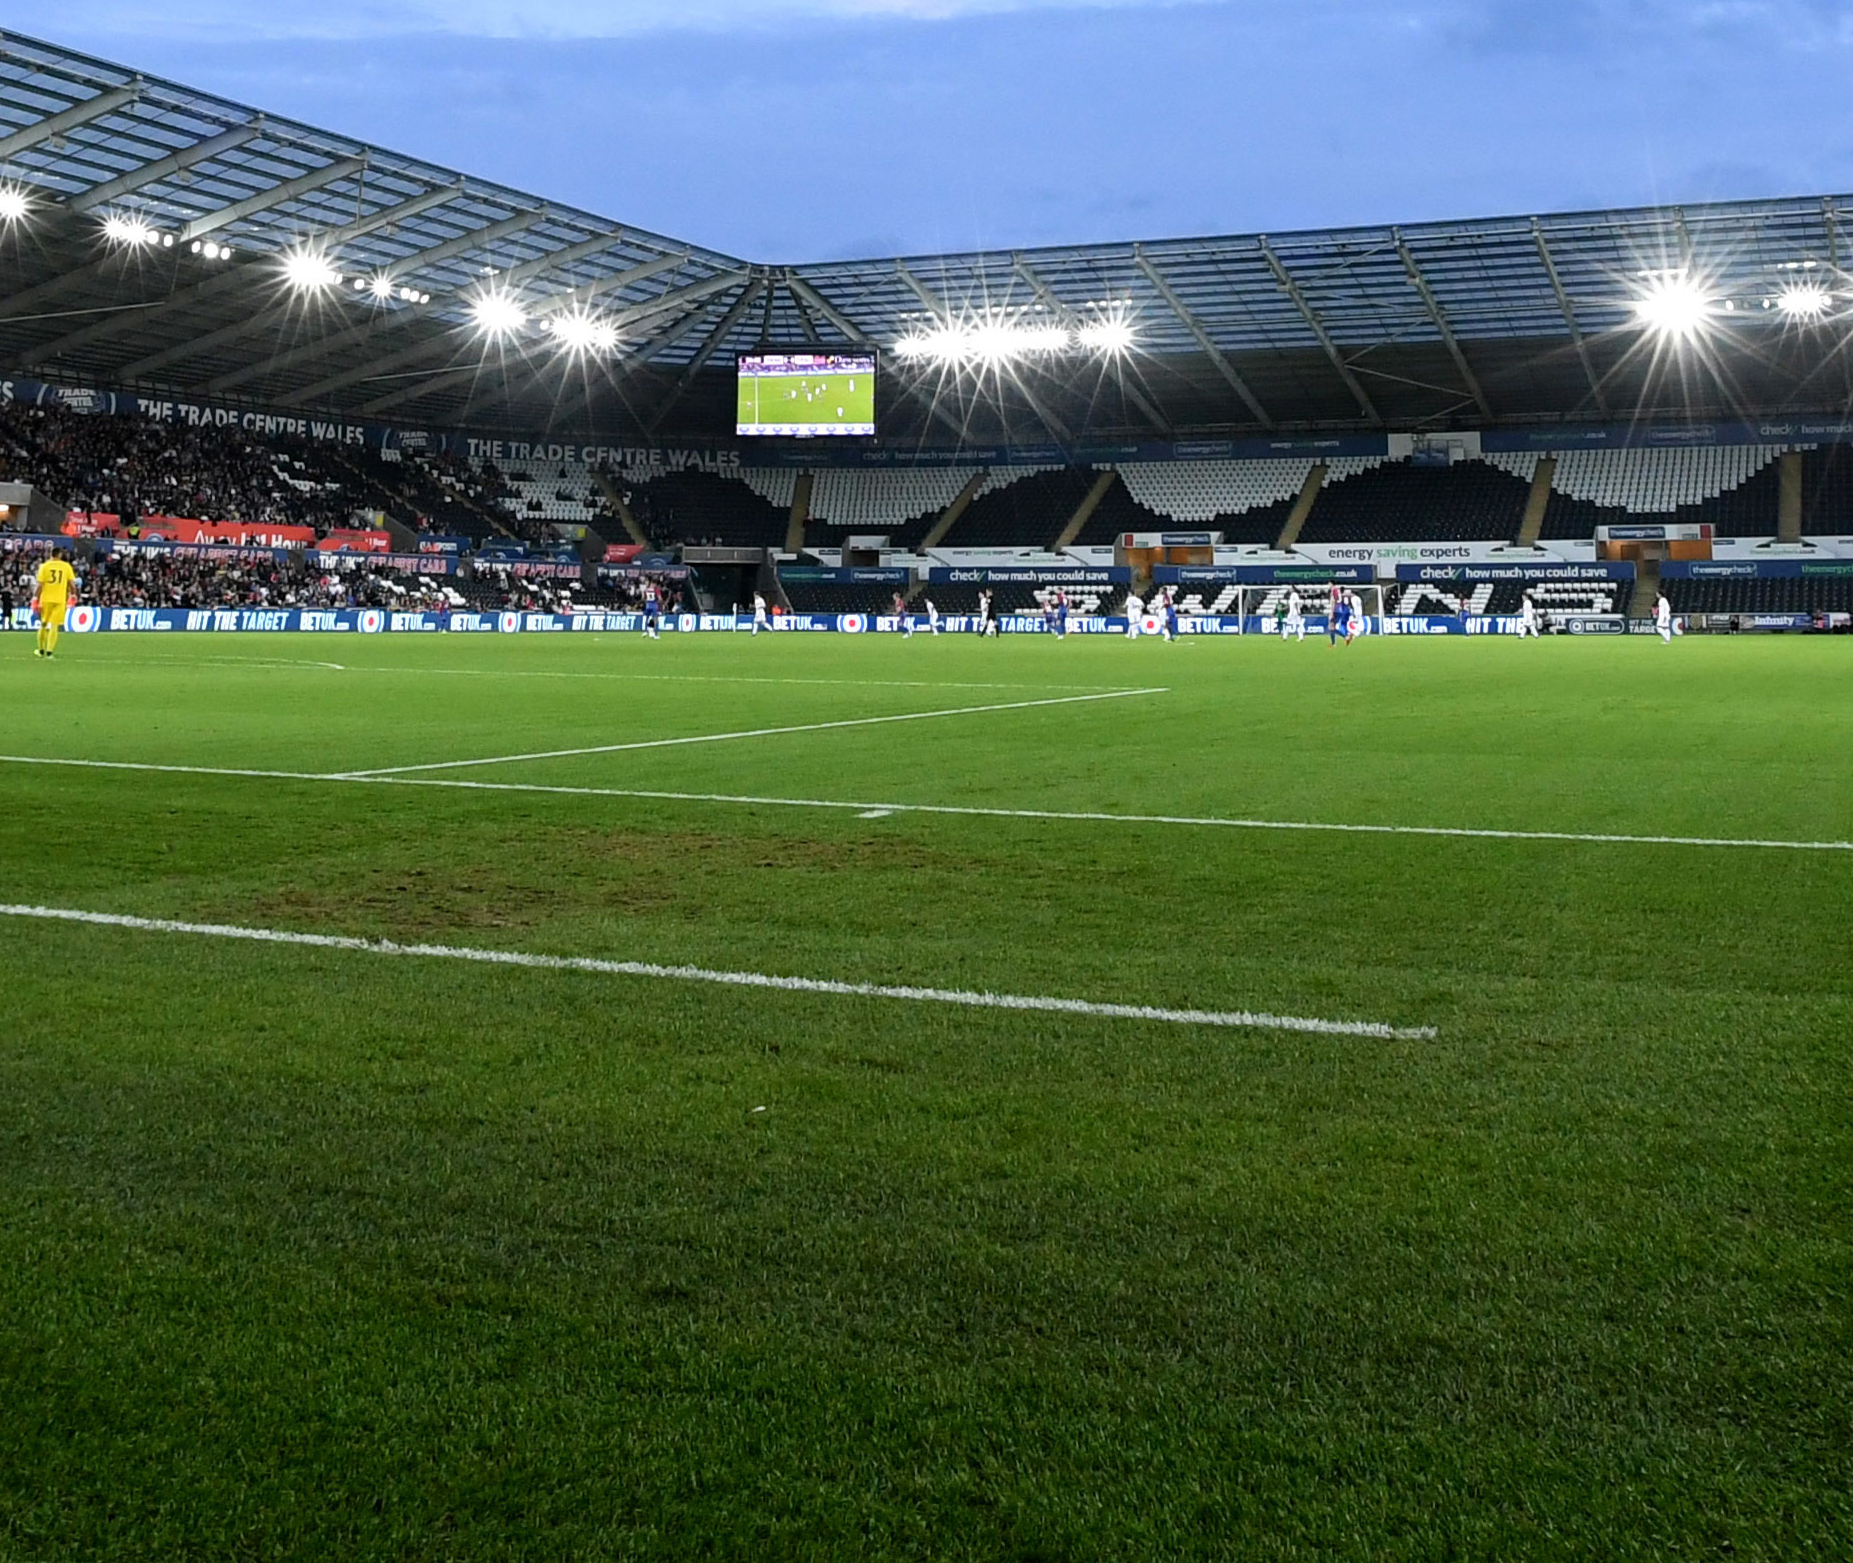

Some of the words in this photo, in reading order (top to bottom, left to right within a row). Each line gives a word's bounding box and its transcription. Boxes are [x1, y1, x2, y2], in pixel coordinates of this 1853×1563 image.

[137, 399, 173, 423] THE
[178, 404, 238, 427] TRADE
[243, 413, 307, 437] CENTRE
[311, 421, 364, 445] WALES
[1759, 423, 1793, 436] check
[1801, 424, 1826, 434] how
[467, 439, 503, 458] THE
[508, 442, 576, 461] TRADE
[581, 446, 661, 466] CENTRE
[666, 449, 740, 468] WALES
[1328, 547, 1374, 560] energy
[1376, 546, 1418, 560] saving
[1420, 546, 1471, 560] experts
[49, 569, 63, 584] 31
[949, 569, 979, 581] check
[988, 569, 1009, 580] how
[1011, 569, 1036, 581] much
[1038, 571, 1056, 583] you
[1057, 569, 1084, 581] could
[1086, 571, 1109, 581] save
[1274, 568, 1358, 580] theenergycheck.co.uk
[1420, 566, 1455, 580] check
[1465, 567, 1489, 579] how
[1491, 567, 1522, 579] much
[1523, 569, 1545, 582] you
[1546, 567, 1579, 579] could
[1580, 569, 1608, 579] save
[1692, 565, 1753, 577] theenergycheck
[110, 609, 172, 630] BETUK.com
[186, 610, 212, 631] HIT
[213, 611, 238, 631] THE
[241, 611, 290, 631] TARGET
[300, 611, 350, 631] BETUK.com
[390, 613, 436, 631] BETUK.com
[450, 614, 493, 631] BETUK.com
[526, 615, 565, 631] BETUK.com
[572, 615, 588, 631] HIT
[588, 615, 605, 631] THE
[606, 615, 636, 631] TARGET
[772, 615, 828, 632] BETUK.com
[876, 615, 931, 632] BETK.com
[944, 617, 969, 632] HIT
[1001, 617, 1048, 633] TARGET
[1065, 617, 1124, 633] BETUK.com
[1177, 617, 1239, 634] BETUK.com
[1382, 617, 1448, 634] BETUK.com
[1465, 617, 1494, 634] HIT
[1497, 617, 1524, 634] THE
[1754, 616, 1795, 628] Infinity
